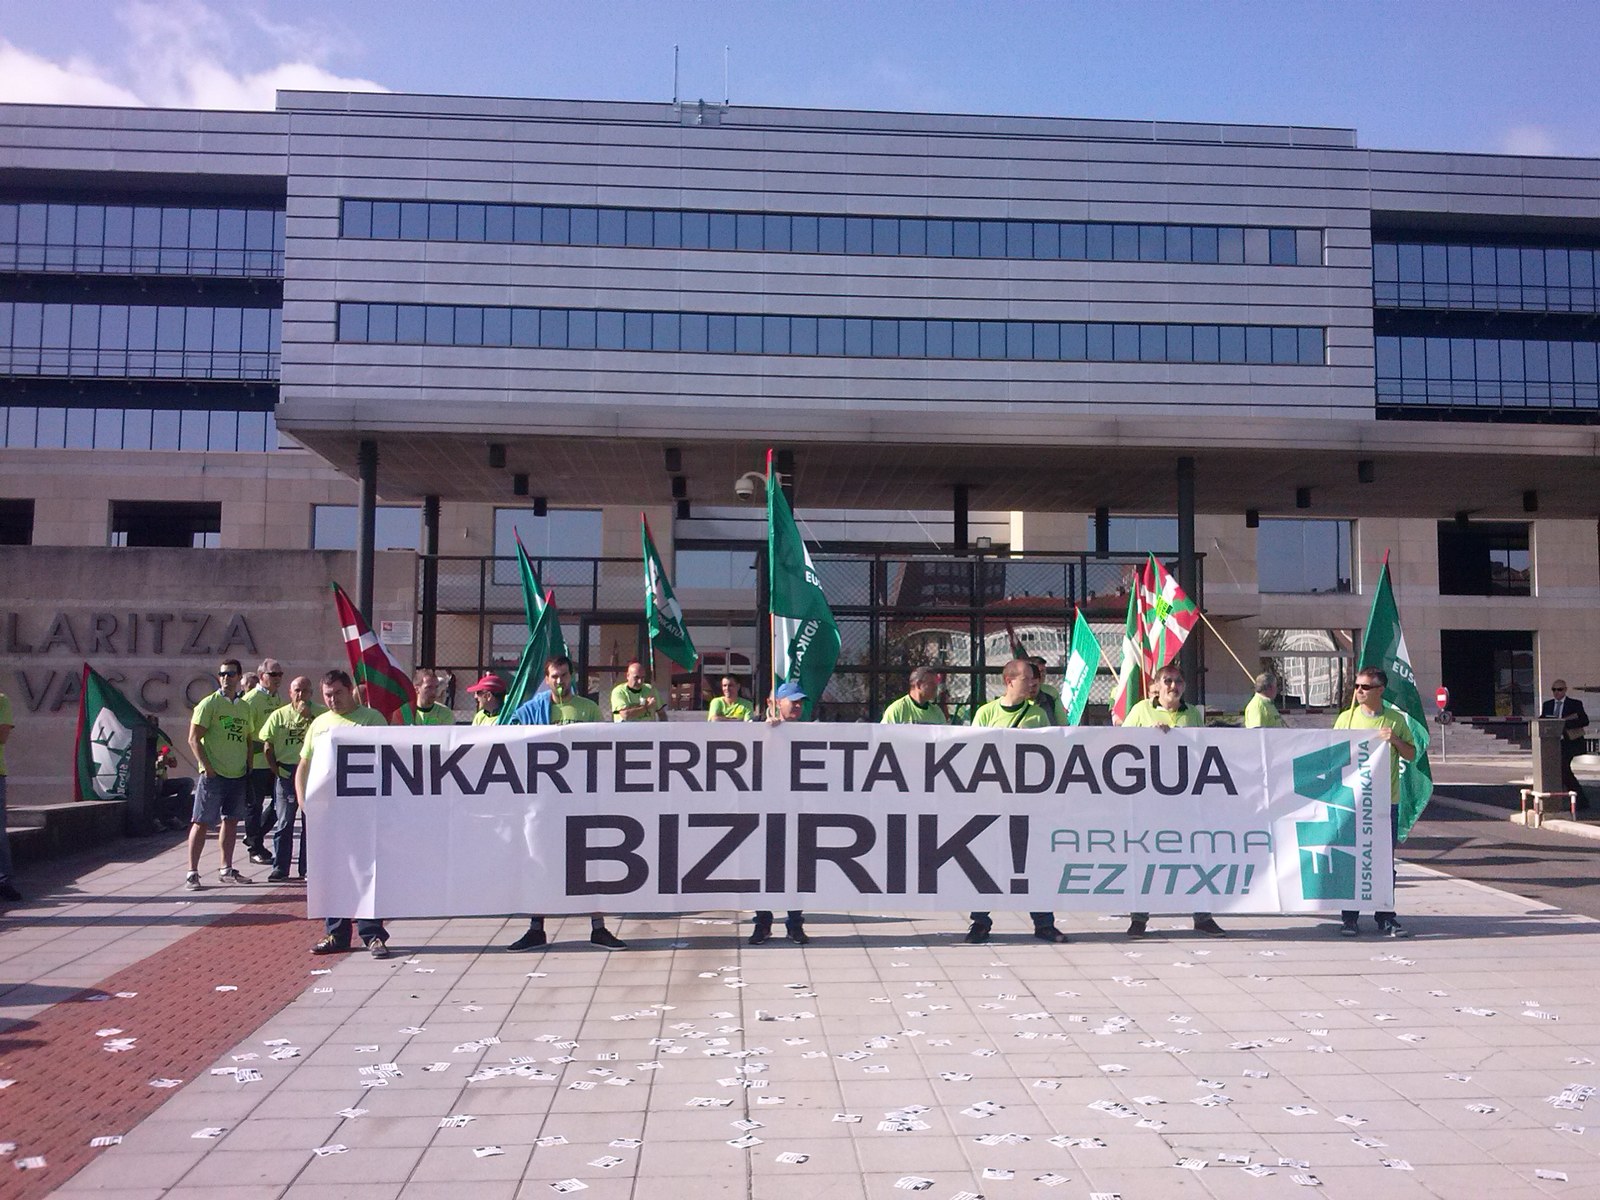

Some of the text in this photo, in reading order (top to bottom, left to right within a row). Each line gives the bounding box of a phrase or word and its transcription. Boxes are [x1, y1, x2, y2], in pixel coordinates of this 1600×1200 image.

[336, 740, 1239, 797] ENKARTERRI ETA KADAGUA
[565, 812, 1030, 897] BIZIRIK!
[1292, 739, 1357, 901] ELA
[1357, 739, 1374, 901] EUSKAL SINDIKATUA
[1056, 863, 1254, 896] EZ ITXI!
